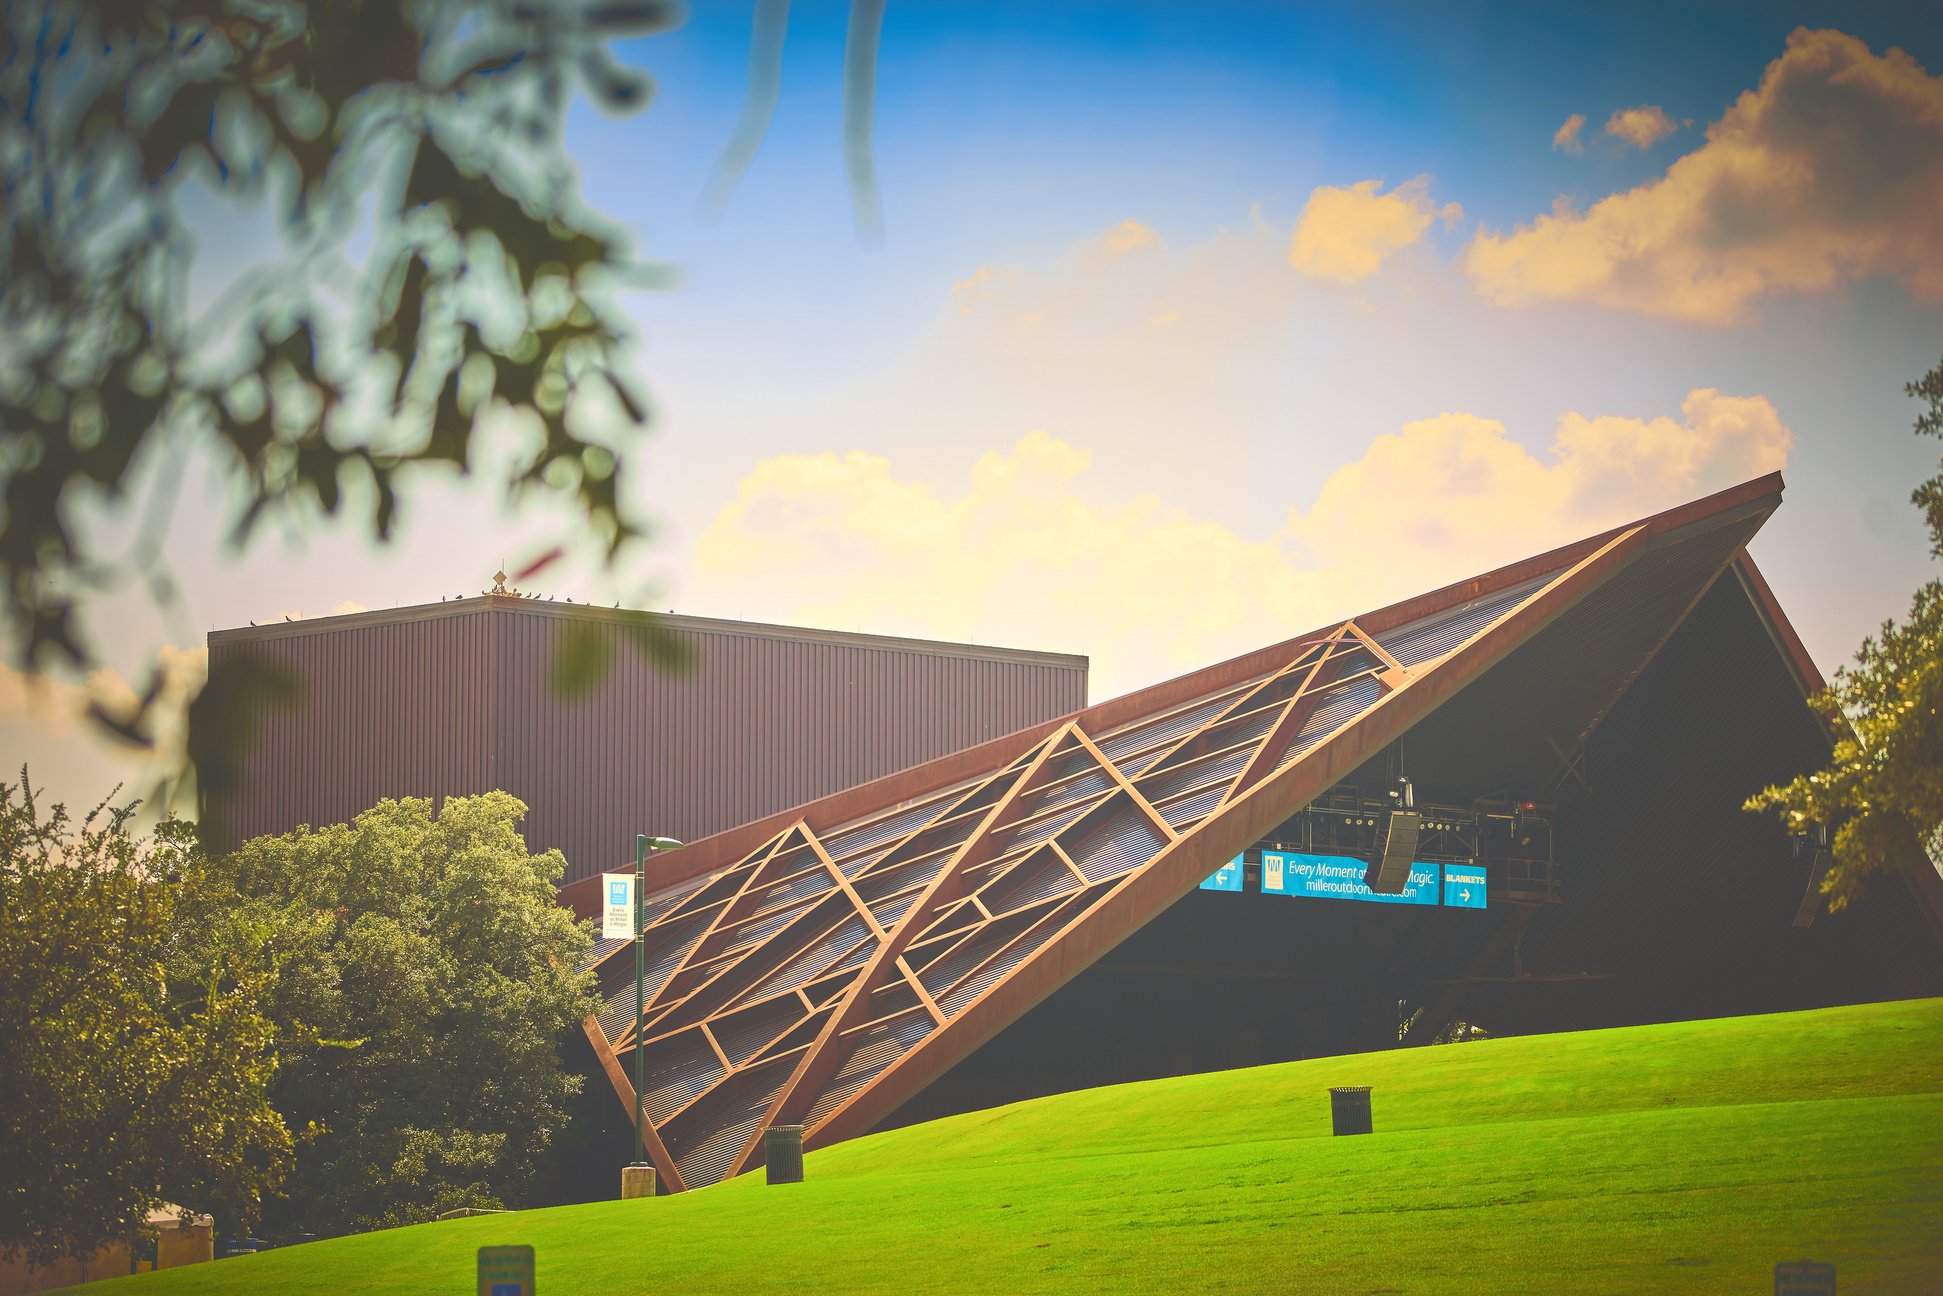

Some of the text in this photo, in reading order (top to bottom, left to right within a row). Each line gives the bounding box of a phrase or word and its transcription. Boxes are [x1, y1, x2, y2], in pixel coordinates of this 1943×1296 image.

[1289, 860, 1316, 879] Every
[1315, 862, 1358, 879] Moment
[1445, 873, 1485, 885] BLANKETS
